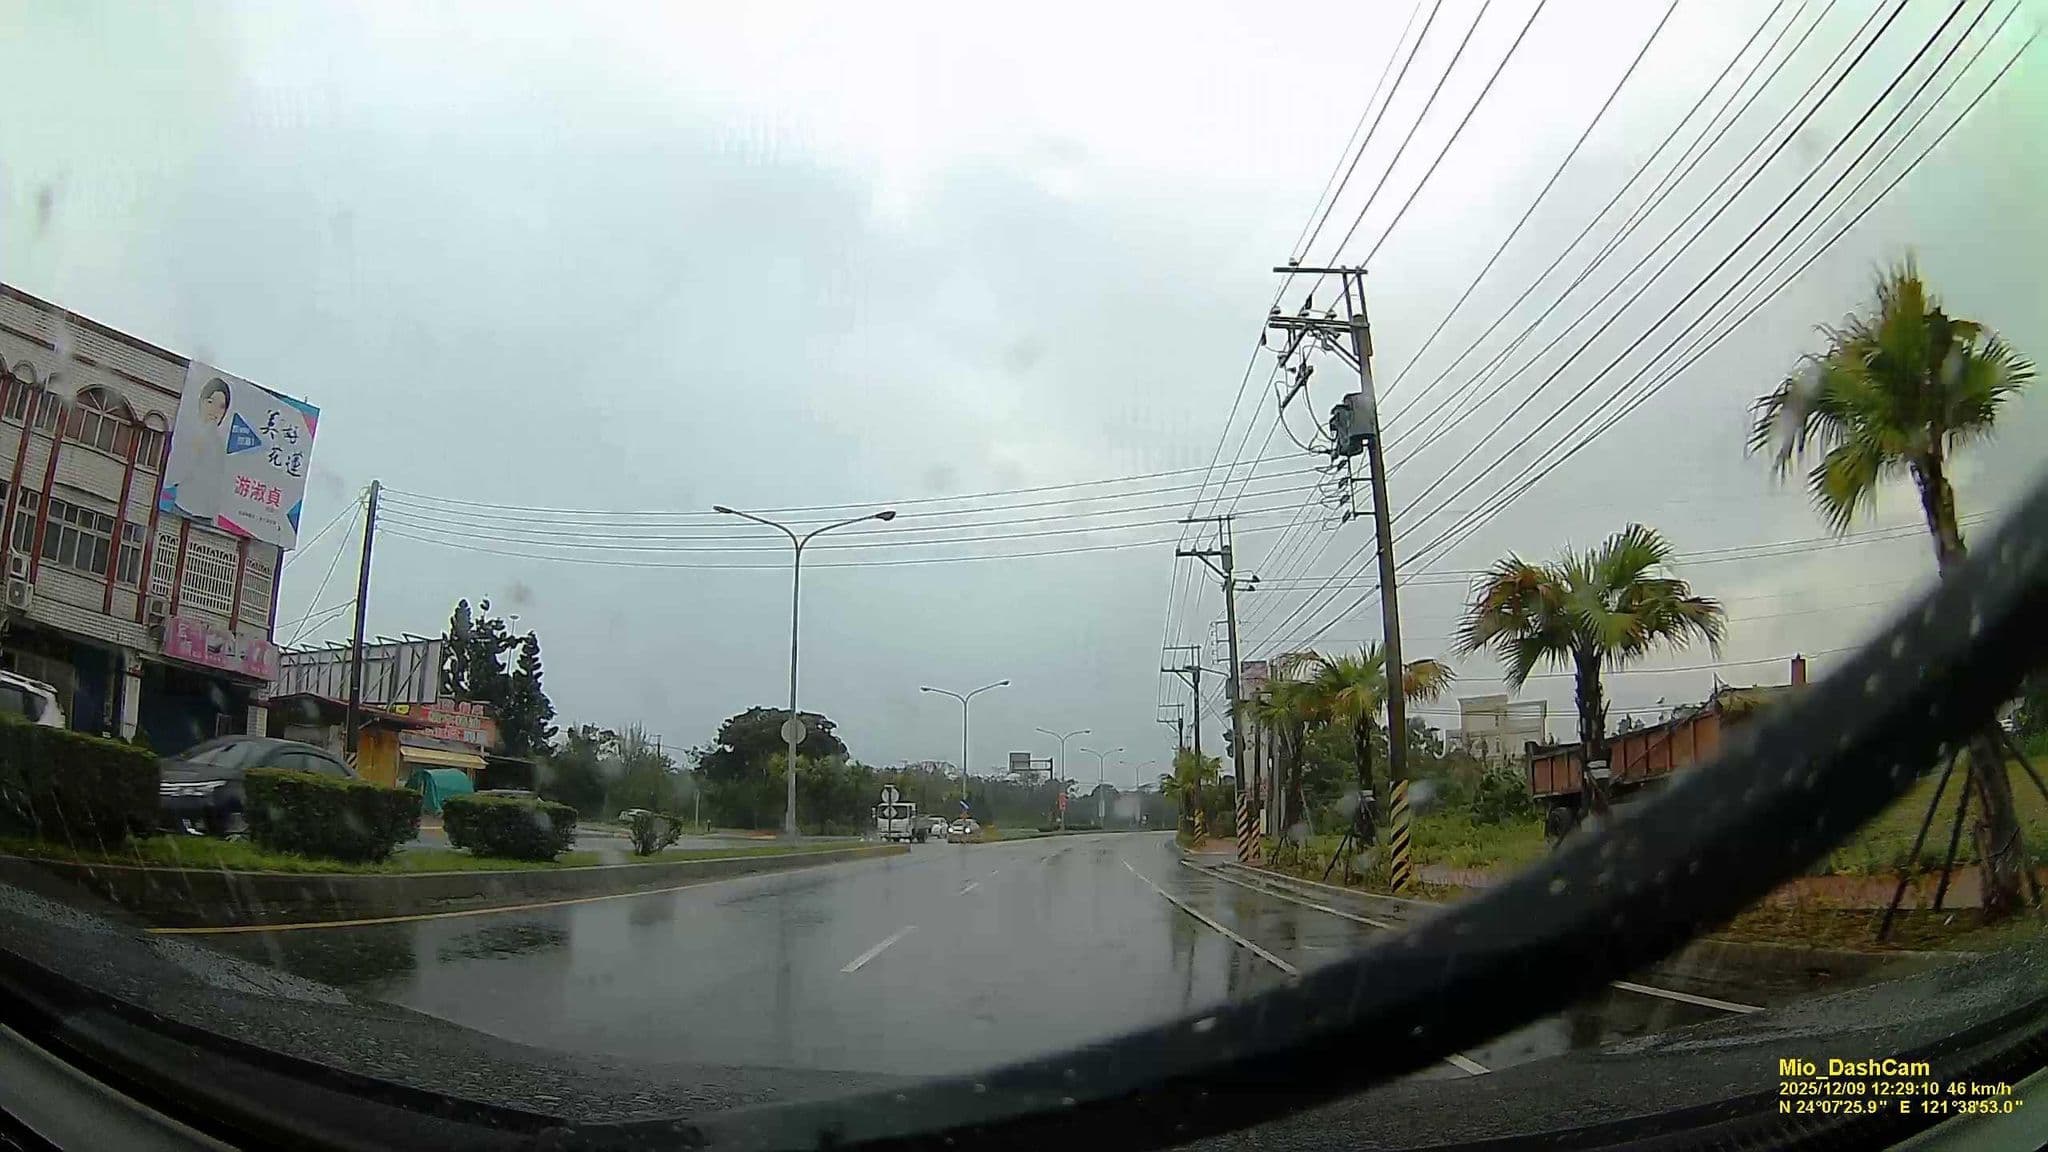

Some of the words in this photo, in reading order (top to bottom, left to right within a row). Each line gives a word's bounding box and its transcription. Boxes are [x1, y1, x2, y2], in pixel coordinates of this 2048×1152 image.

[260, 409, 299, 444] 美好
[268, 447, 303, 477] 花蓮
[233, 475, 281, 508] 游淑貞
